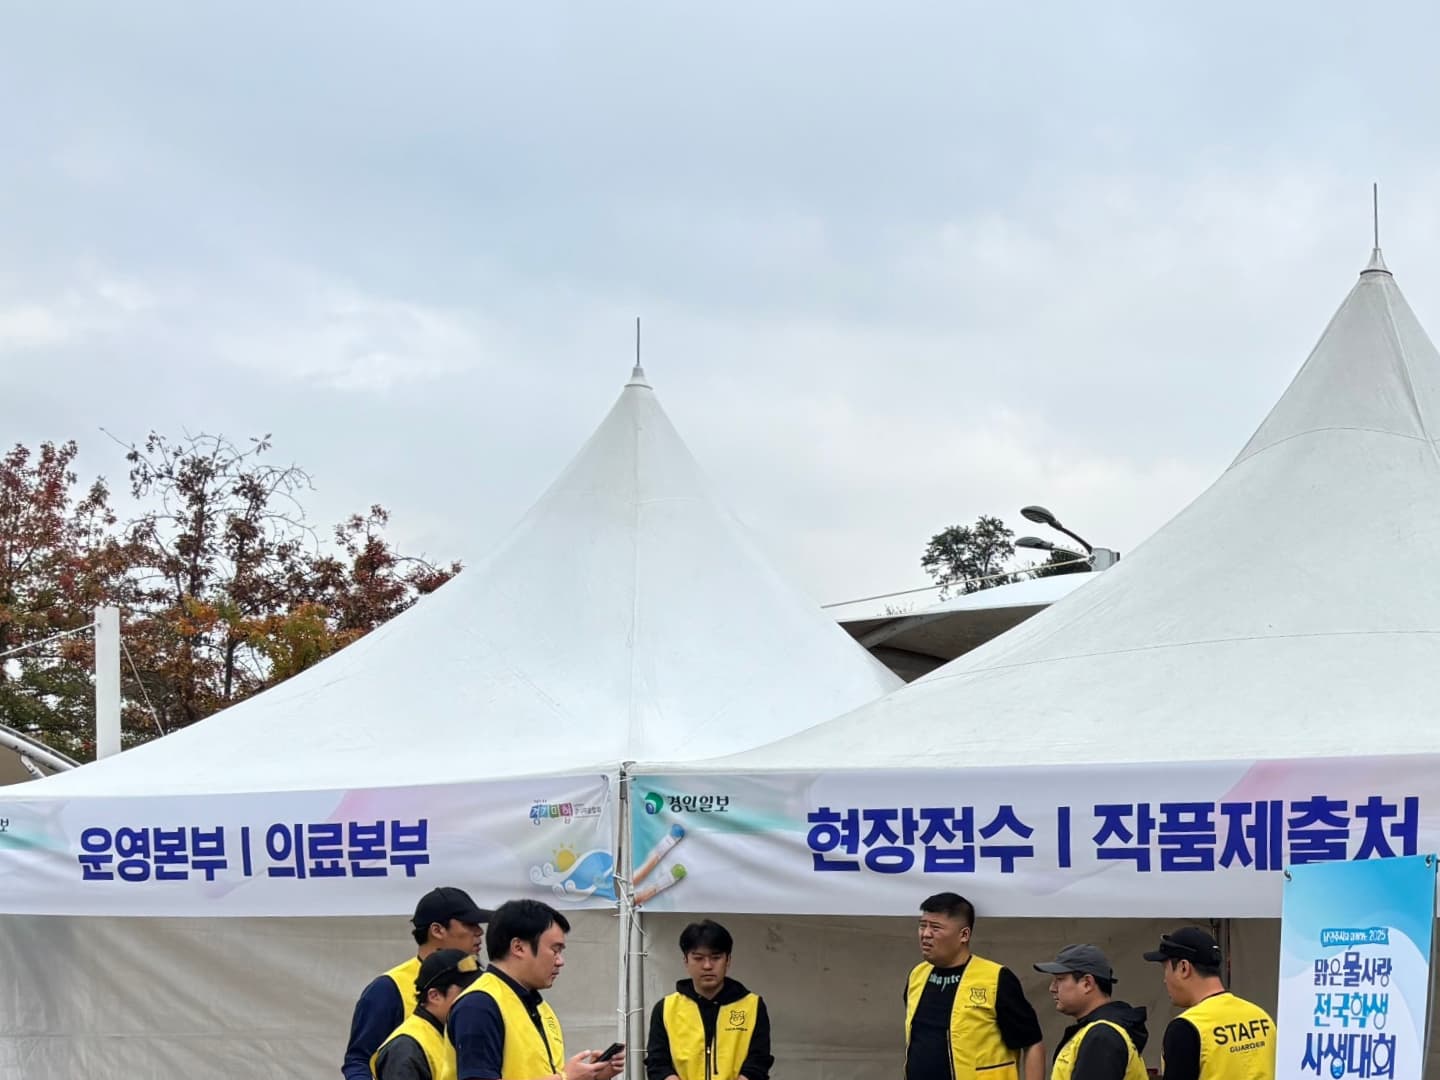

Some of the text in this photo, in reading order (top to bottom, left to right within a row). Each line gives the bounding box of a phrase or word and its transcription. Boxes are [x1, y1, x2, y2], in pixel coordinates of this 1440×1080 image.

[667, 795, 729, 812] 경인일보
[78, 826, 228, 882] 운영본부
[266, 818, 430, 879] 의료본부
[806, 805, 1034, 873] 현장접수
[1092, 796, 1420, 872] 작품제출처
[1369, 929, 1386, 941] 2025
[1314, 952, 1392, 987] 맑은물사랑
[1314, 992, 1389, 1030] 전국학생
[1213, 1019, 1270, 1045] STAFF
[1301, 1033, 1396, 1080] 사생대회
